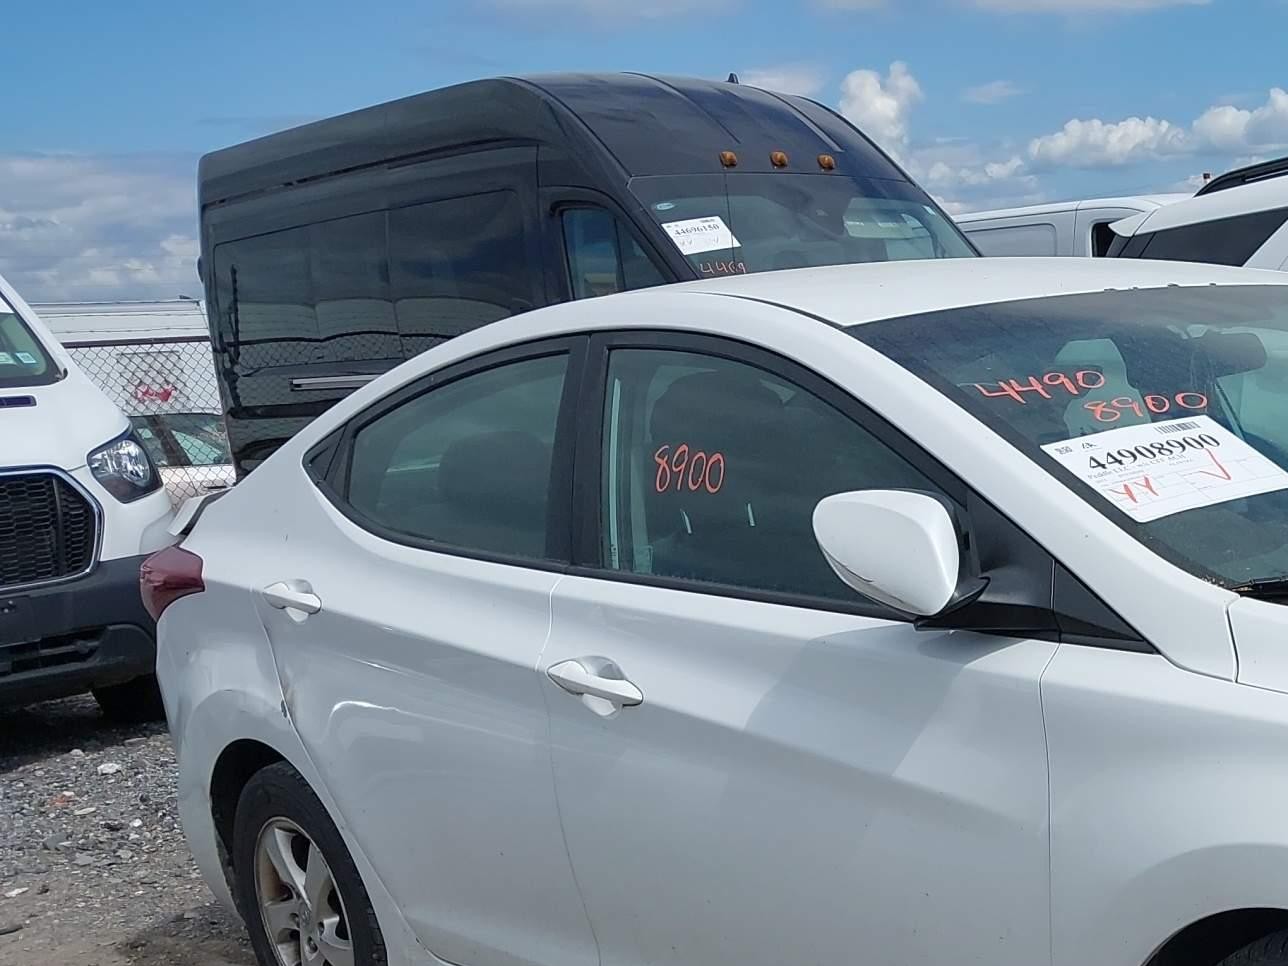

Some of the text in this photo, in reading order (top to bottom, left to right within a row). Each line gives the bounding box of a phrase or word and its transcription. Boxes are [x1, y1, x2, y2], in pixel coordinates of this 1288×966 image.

[974, 370, 1105, 404] 4490
[1084, 392, 1208, 422] 8900
[654, 444, 725, 494] 8900
[1088, 433, 1221, 471] 44908900
